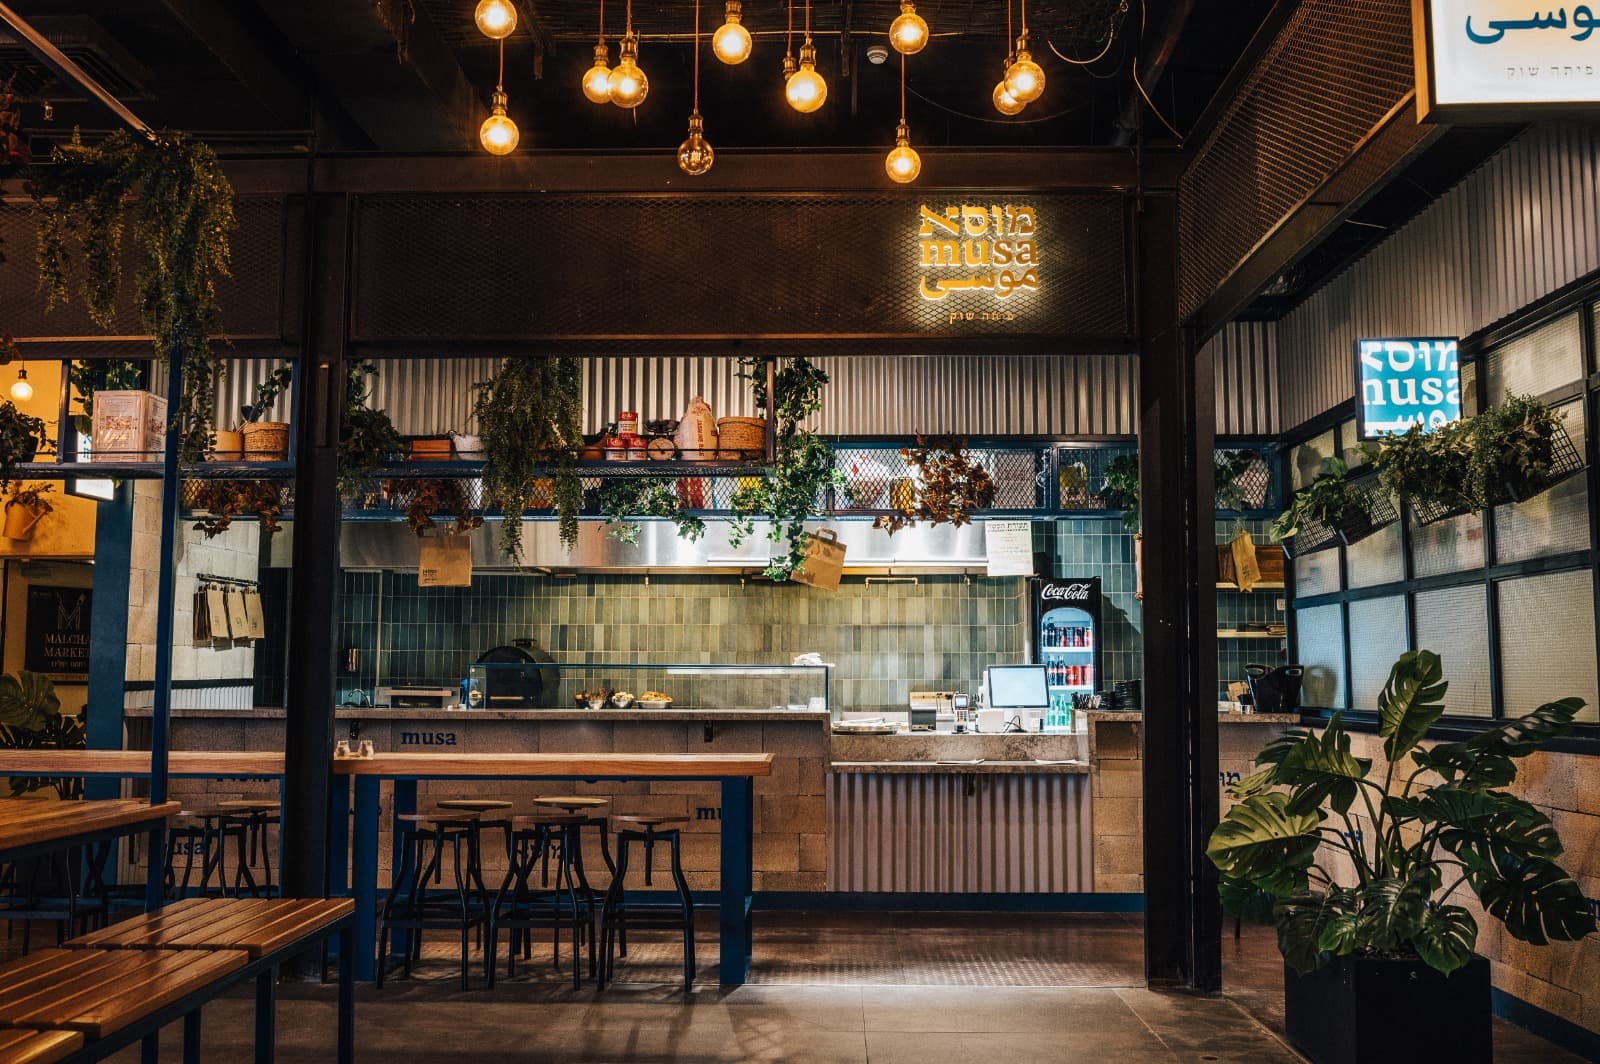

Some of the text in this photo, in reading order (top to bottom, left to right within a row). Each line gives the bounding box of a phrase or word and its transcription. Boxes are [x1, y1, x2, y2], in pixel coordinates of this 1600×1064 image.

[1465, 5, 1600, 45] وسى
[1506, 66, 1540, 80] שוק
[919, 239, 1039, 266] musa
[919, 268, 1040, 300] موسى
[1041, 583, 1092, 600] Coca-Cola
[401, 731, 457, 746] musa
